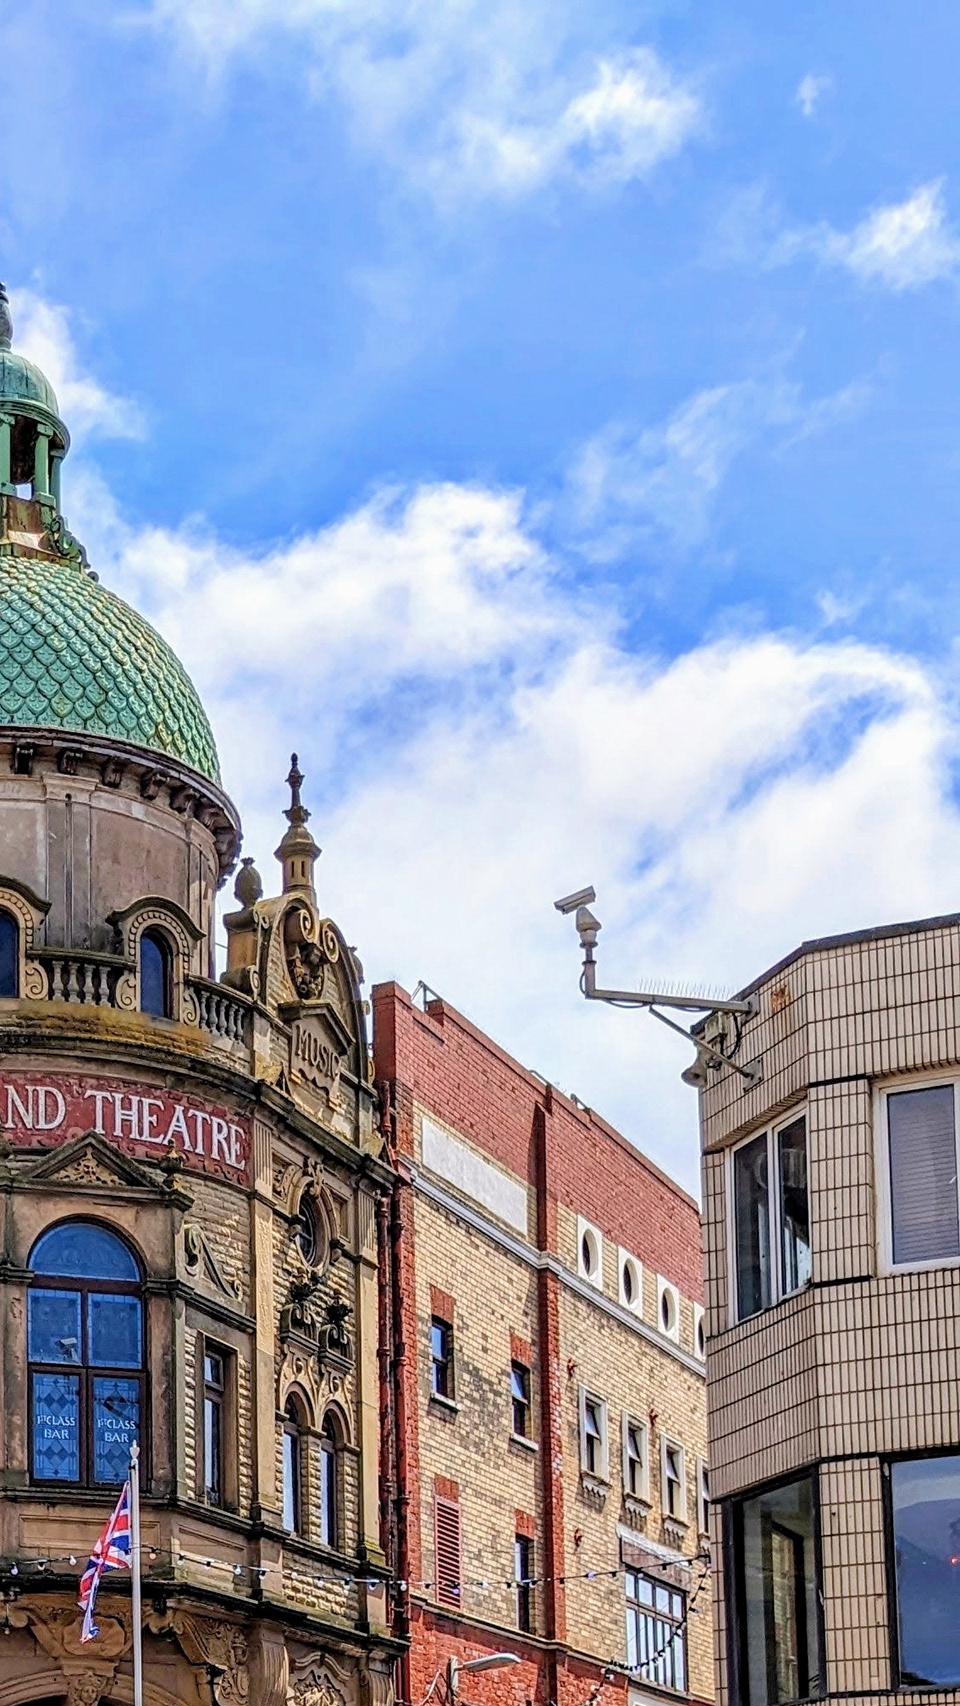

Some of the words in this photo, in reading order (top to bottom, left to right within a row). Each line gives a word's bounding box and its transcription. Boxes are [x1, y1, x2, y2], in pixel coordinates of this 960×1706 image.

[295, 1024, 340, 1081] MUSIC
[85, 1089, 246, 1171] THEATRE
[46, 1415, 76, 1426] CLASS
[106, 1419, 136, 1430] CLASS
[44, 1428, 69, 1440] BAR
[104, 1431, 129, 1443] BAR
